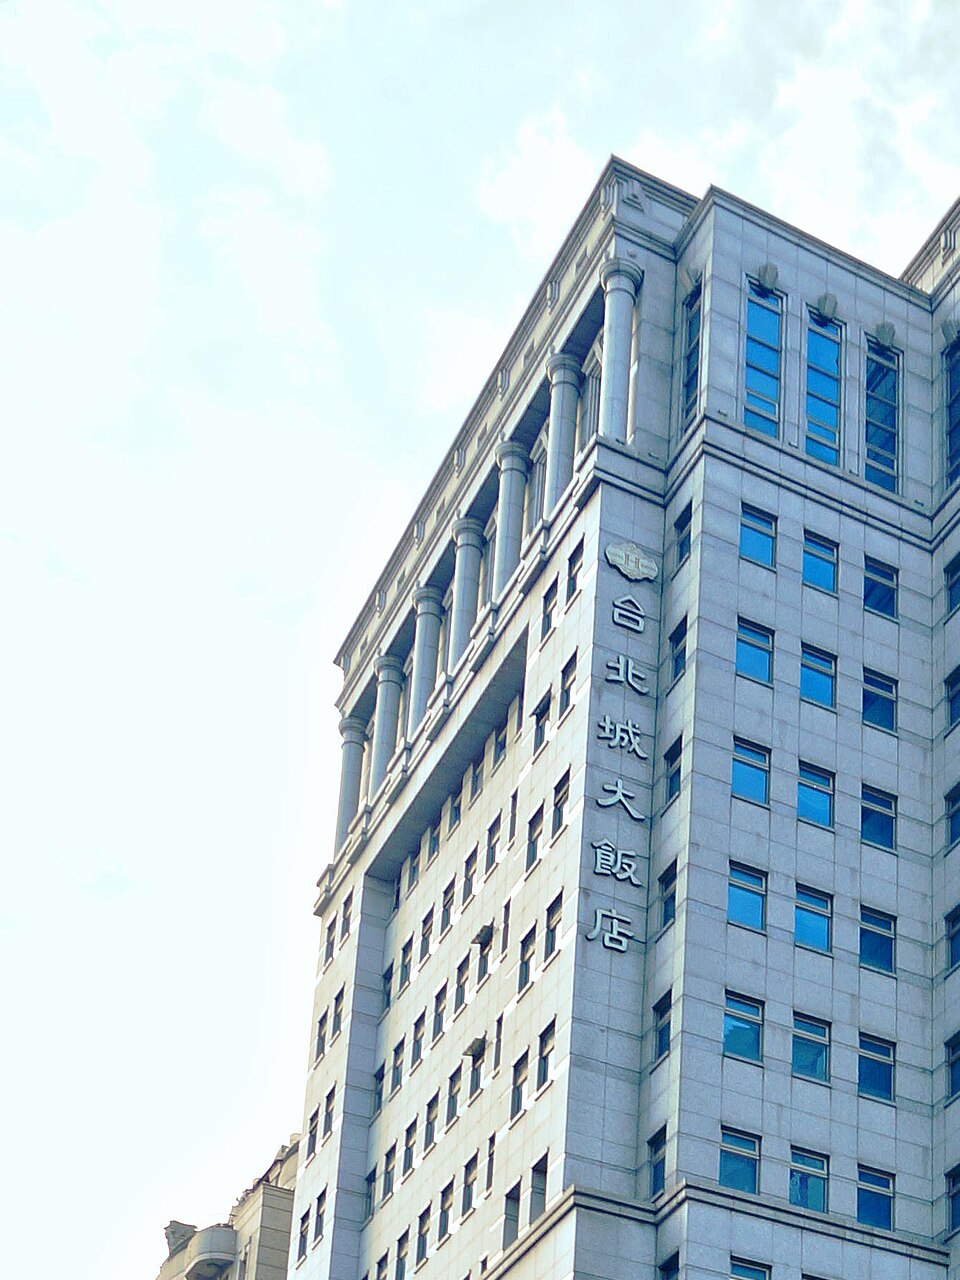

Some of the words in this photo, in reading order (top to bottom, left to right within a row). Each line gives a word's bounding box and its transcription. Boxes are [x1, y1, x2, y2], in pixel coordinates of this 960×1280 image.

[586, 593, 651, 953] 台北城大飯店
